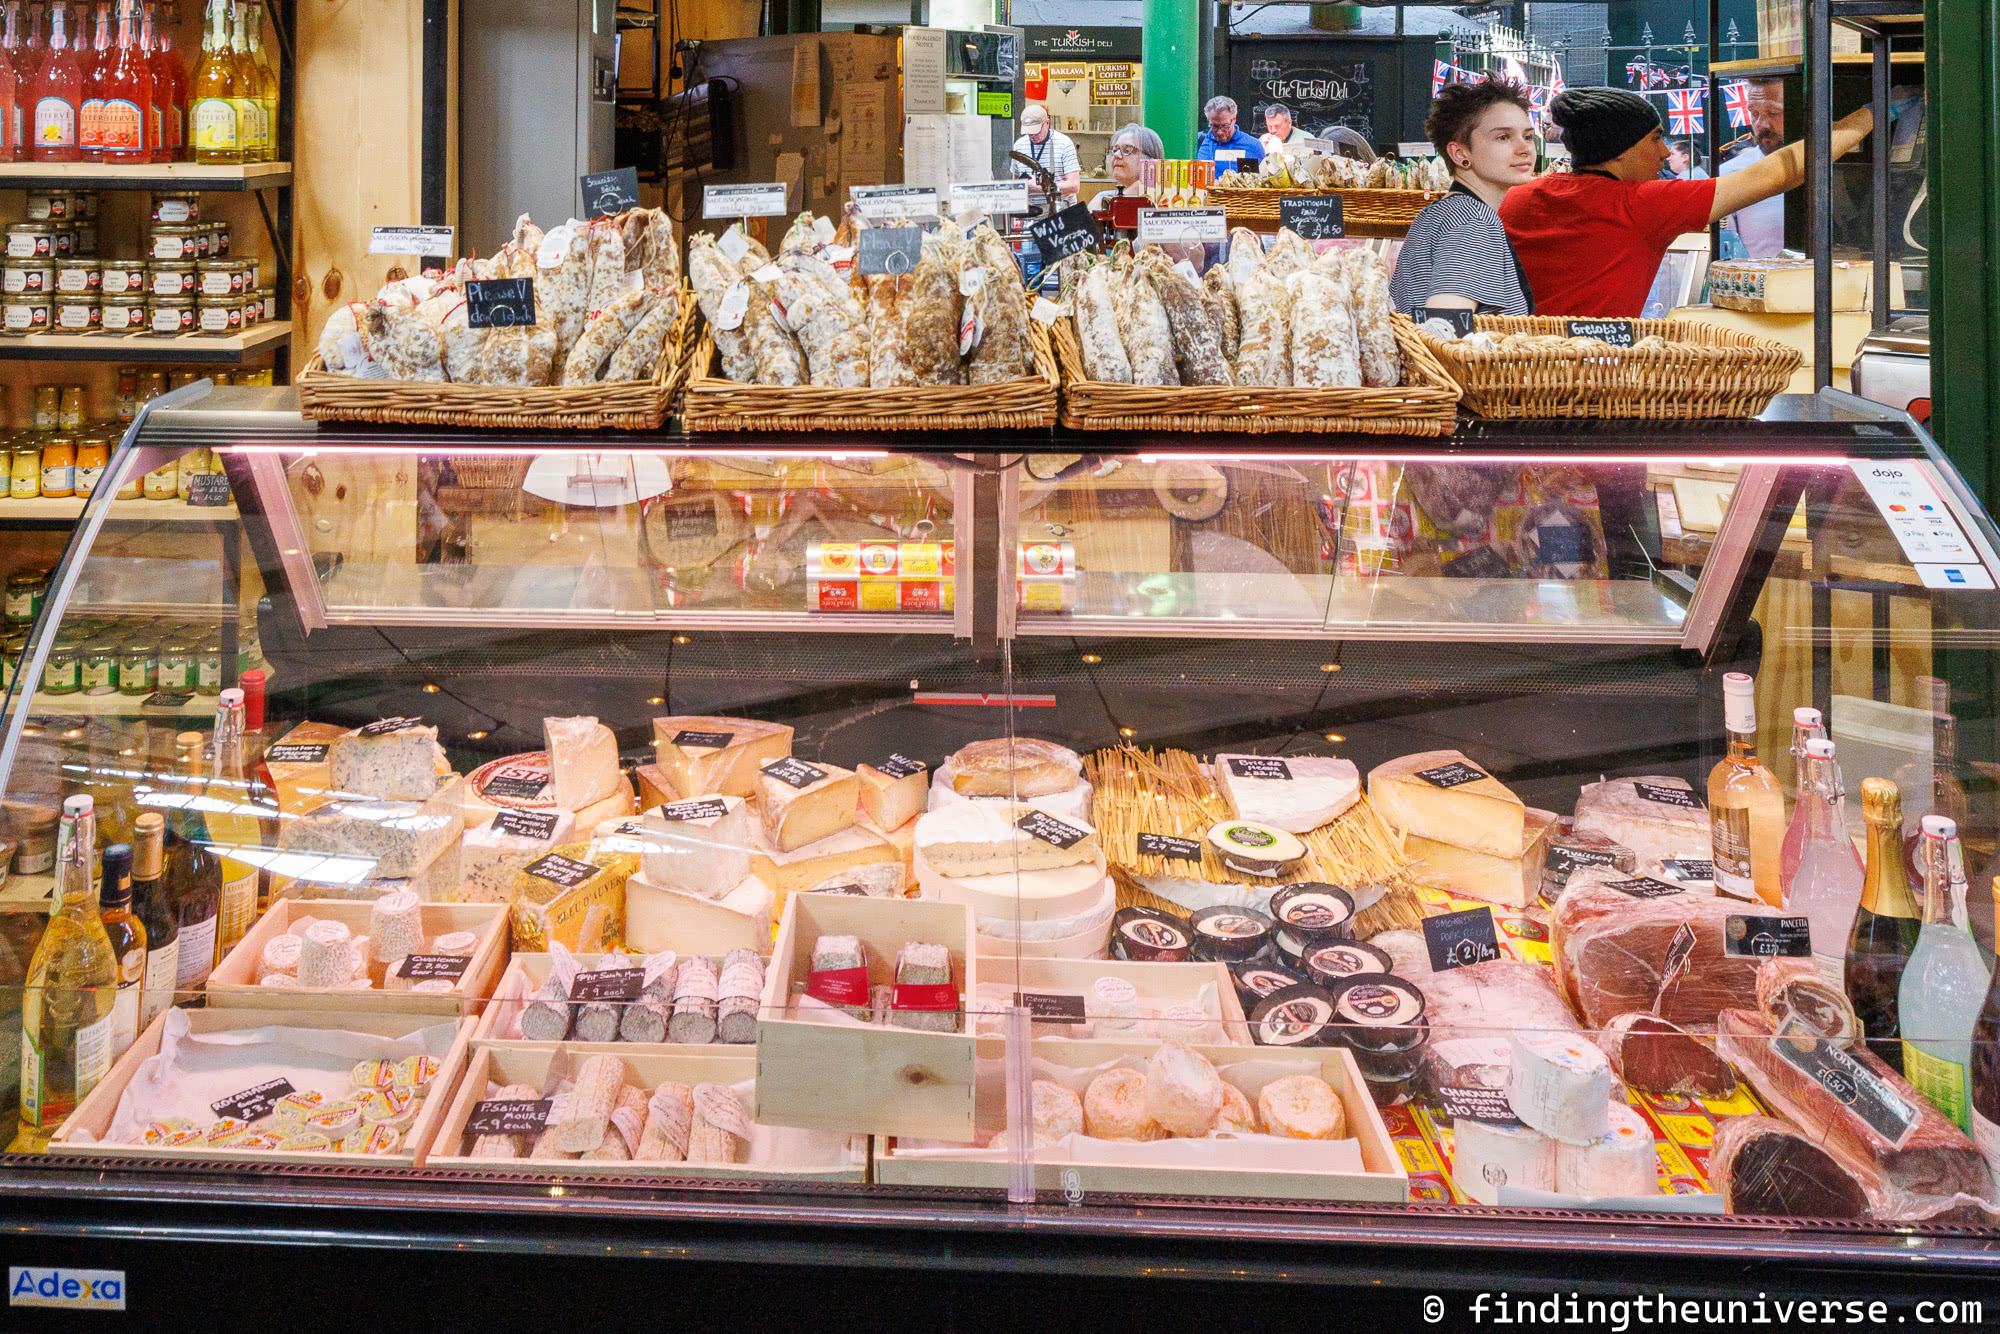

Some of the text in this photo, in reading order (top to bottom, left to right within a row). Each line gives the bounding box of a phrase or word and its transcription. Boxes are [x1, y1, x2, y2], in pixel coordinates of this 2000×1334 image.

[1051, 38, 1095, 47] TURKISH
[1050, 67, 1084, 75] BAKLAVA
[1099, 83, 1128, 91] NITRO
[1266, 80, 1291, 98] The
[1290, 79, 1328, 100] Turkish
[1872, 469, 1903, 479] dojo
[1780, 919, 1808, 929] PANCETTA
[603, 988, 625, 996] each
[1825, 1045, 1852, 1071] NOIX
[503, 1122, 532, 1130] each
[12, 1270, 121, 1300] Adexa
